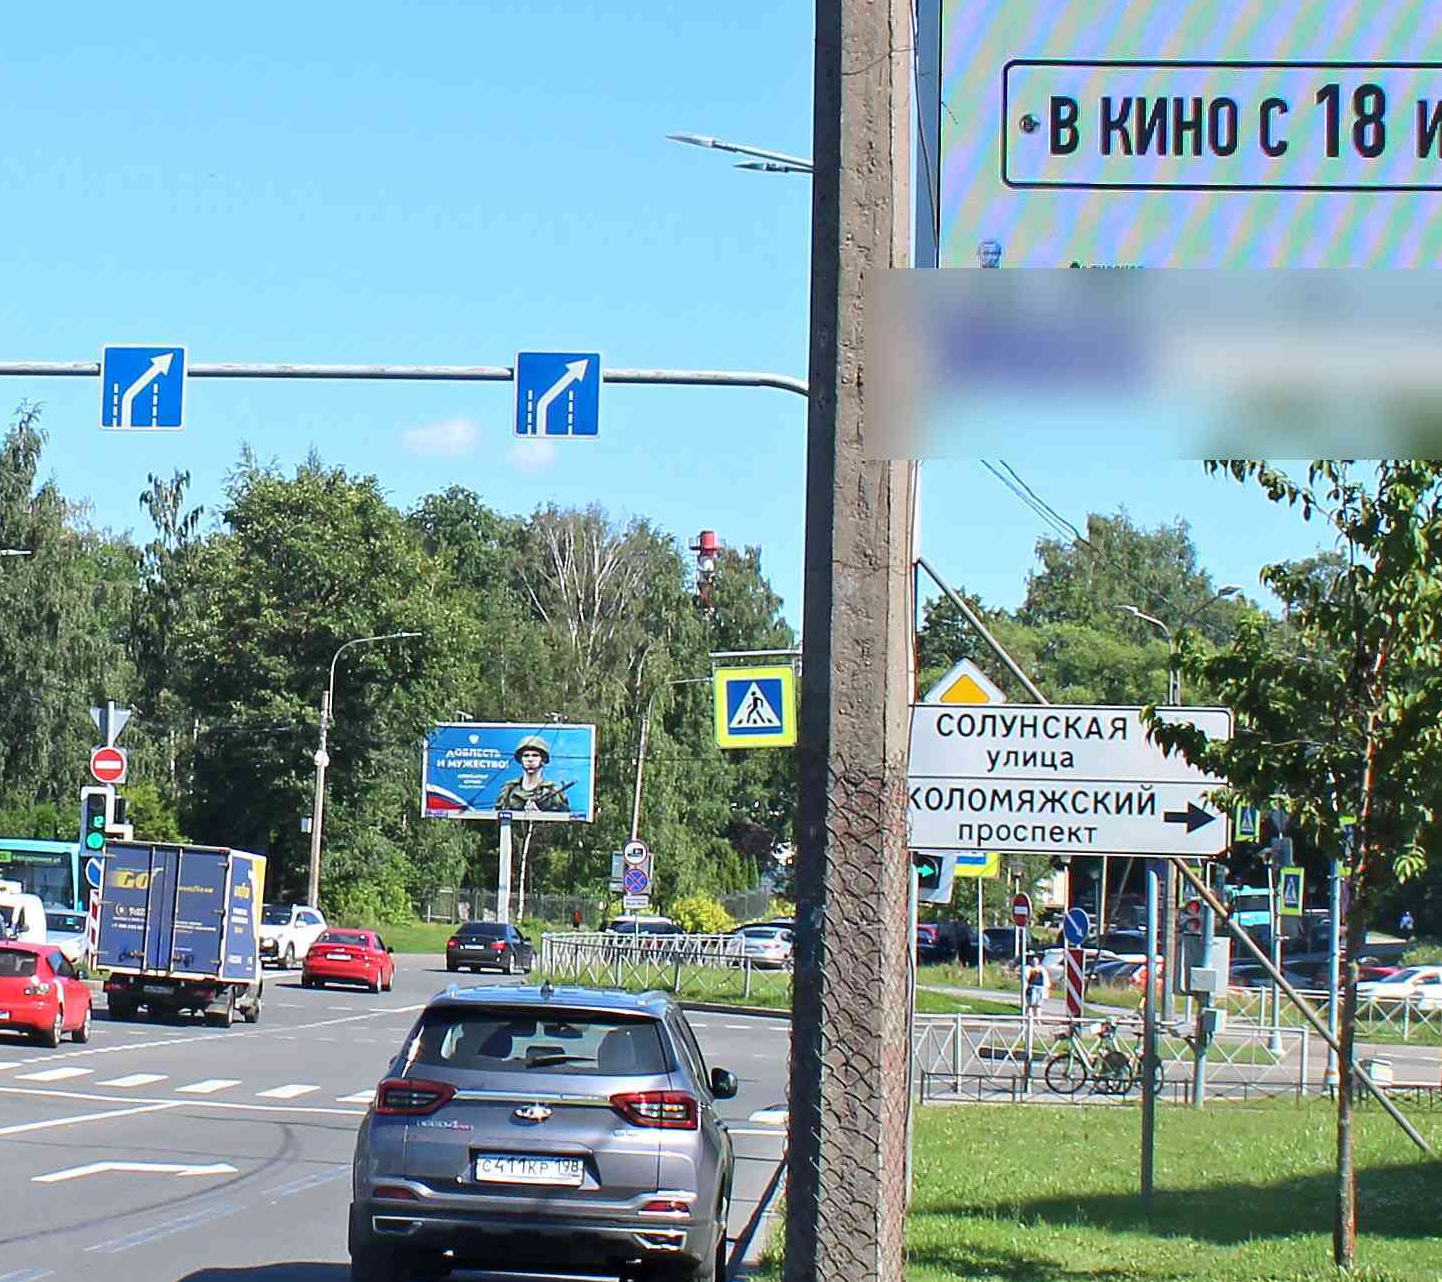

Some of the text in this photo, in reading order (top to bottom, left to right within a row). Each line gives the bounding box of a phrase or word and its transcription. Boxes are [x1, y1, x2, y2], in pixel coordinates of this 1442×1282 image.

[1048, 95, 1081, 157] В
[1098, 95, 1238, 158] КИНО
[1257, 96, 1290, 158] С
[1314, 82, 1388, 160] 18
[936, 713, 1128, 741] СОЛУНСКАЯ
[985, 749, 1075, 772] улица
[958, 822, 1098, 846] проспект
